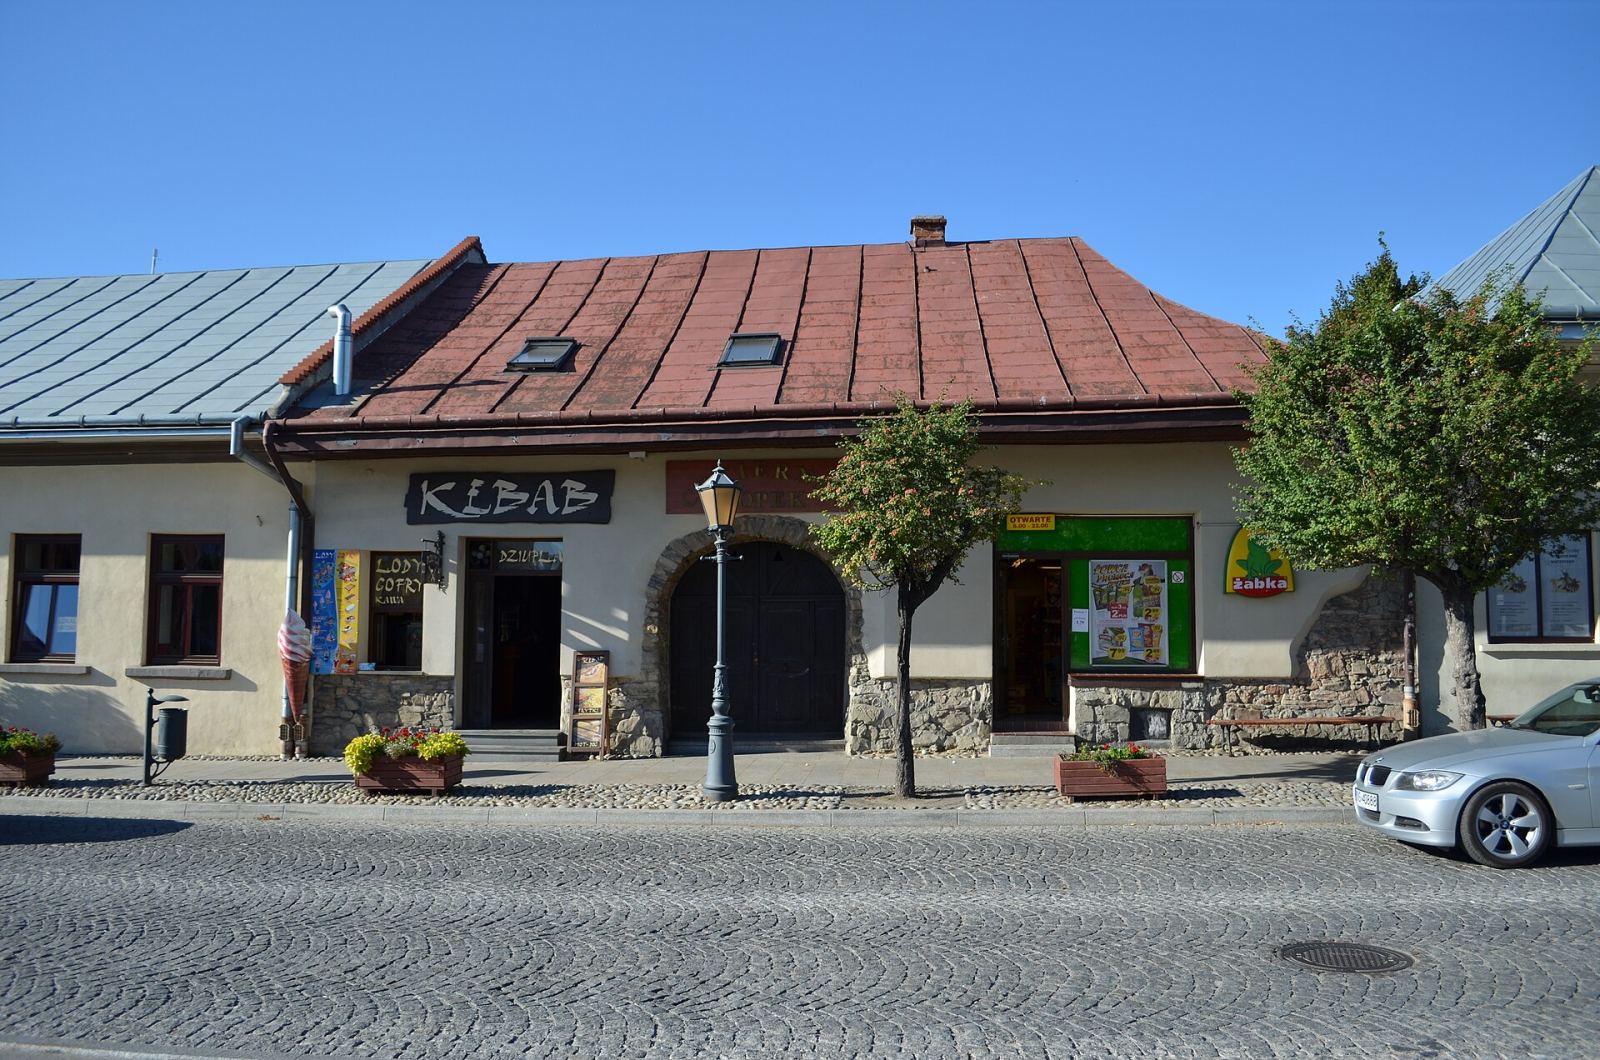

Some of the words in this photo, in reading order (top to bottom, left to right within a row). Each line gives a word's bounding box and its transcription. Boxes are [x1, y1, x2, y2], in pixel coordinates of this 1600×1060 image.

[420, 478, 598, 518] KEBAB
[375, 558, 422, 574] LODY
[375, 577, 422, 593] GOFRY
[1233, 577, 1288, 590] żabka
